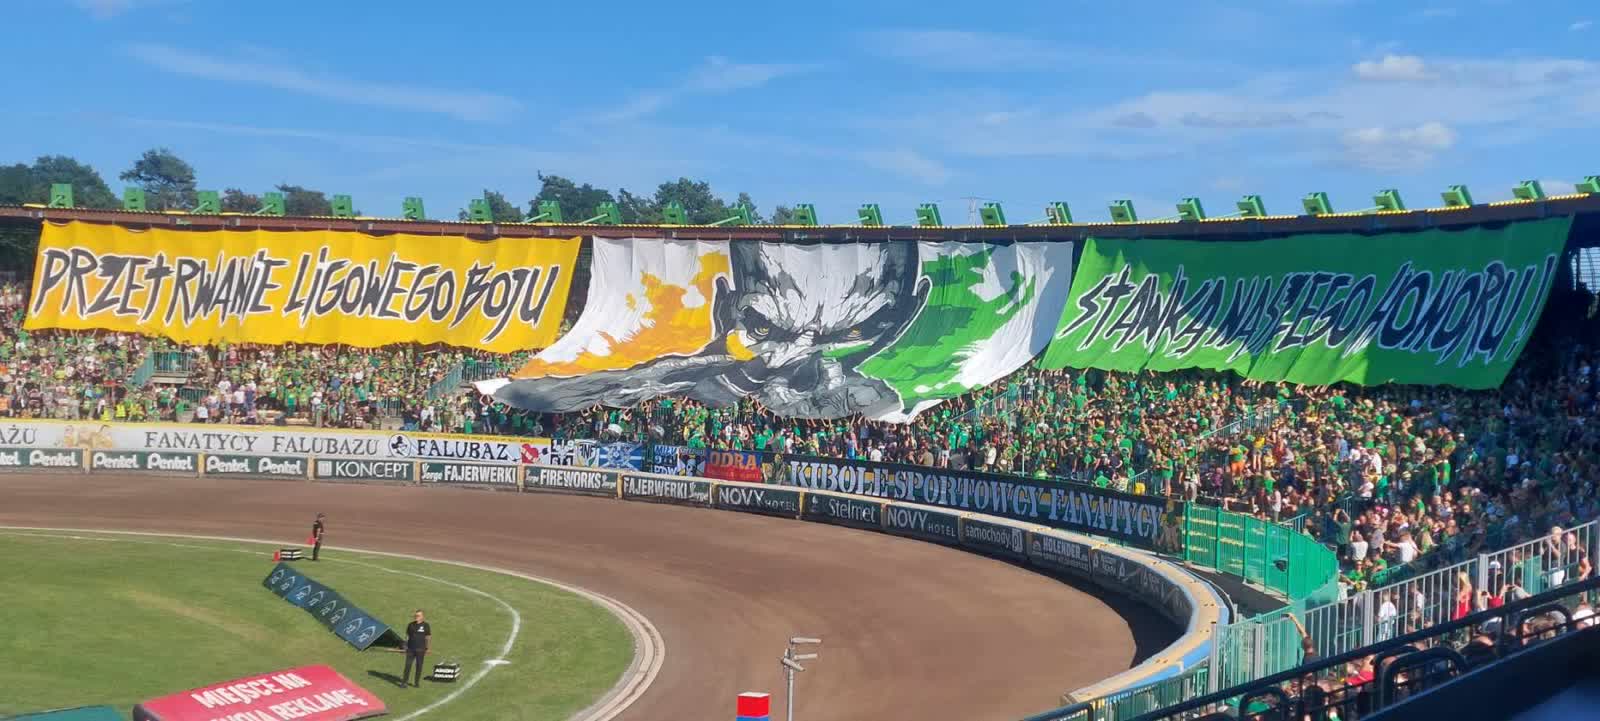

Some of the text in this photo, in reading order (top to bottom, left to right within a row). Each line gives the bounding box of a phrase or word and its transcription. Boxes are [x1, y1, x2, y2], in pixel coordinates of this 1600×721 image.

[449, 260, 561, 345] BOJU
[144, 431, 259, 451] FANATYCY
[417, 439, 509, 461] FALUBAZ
[29, 449, 78, 467] Pentel
[93, 452, 193, 470] Pentel Pentel
[206, 455, 303, 475] Pentel Pentel
[711, 451, 757, 471] ODRA
[335, 461, 409, 478] KONCEPT
[444, 465, 517, 484] FAJERWERKI
[540, 469, 602, 489] FIREWORKS
[623, 477, 688, 499] FAJERWERKI
[719, 487, 797, 512] NOVY HOTEL
[789, 461, 1163, 538] KIBOLE SPORTOWCY FANATYCY
[828, 498, 876, 523] Stelmet
[887, 507, 956, 537] NOVY HOTEL
[190, 673, 312, 708] MIEJSCE NA
[269, 689, 369, 720] REKLAMĘ
